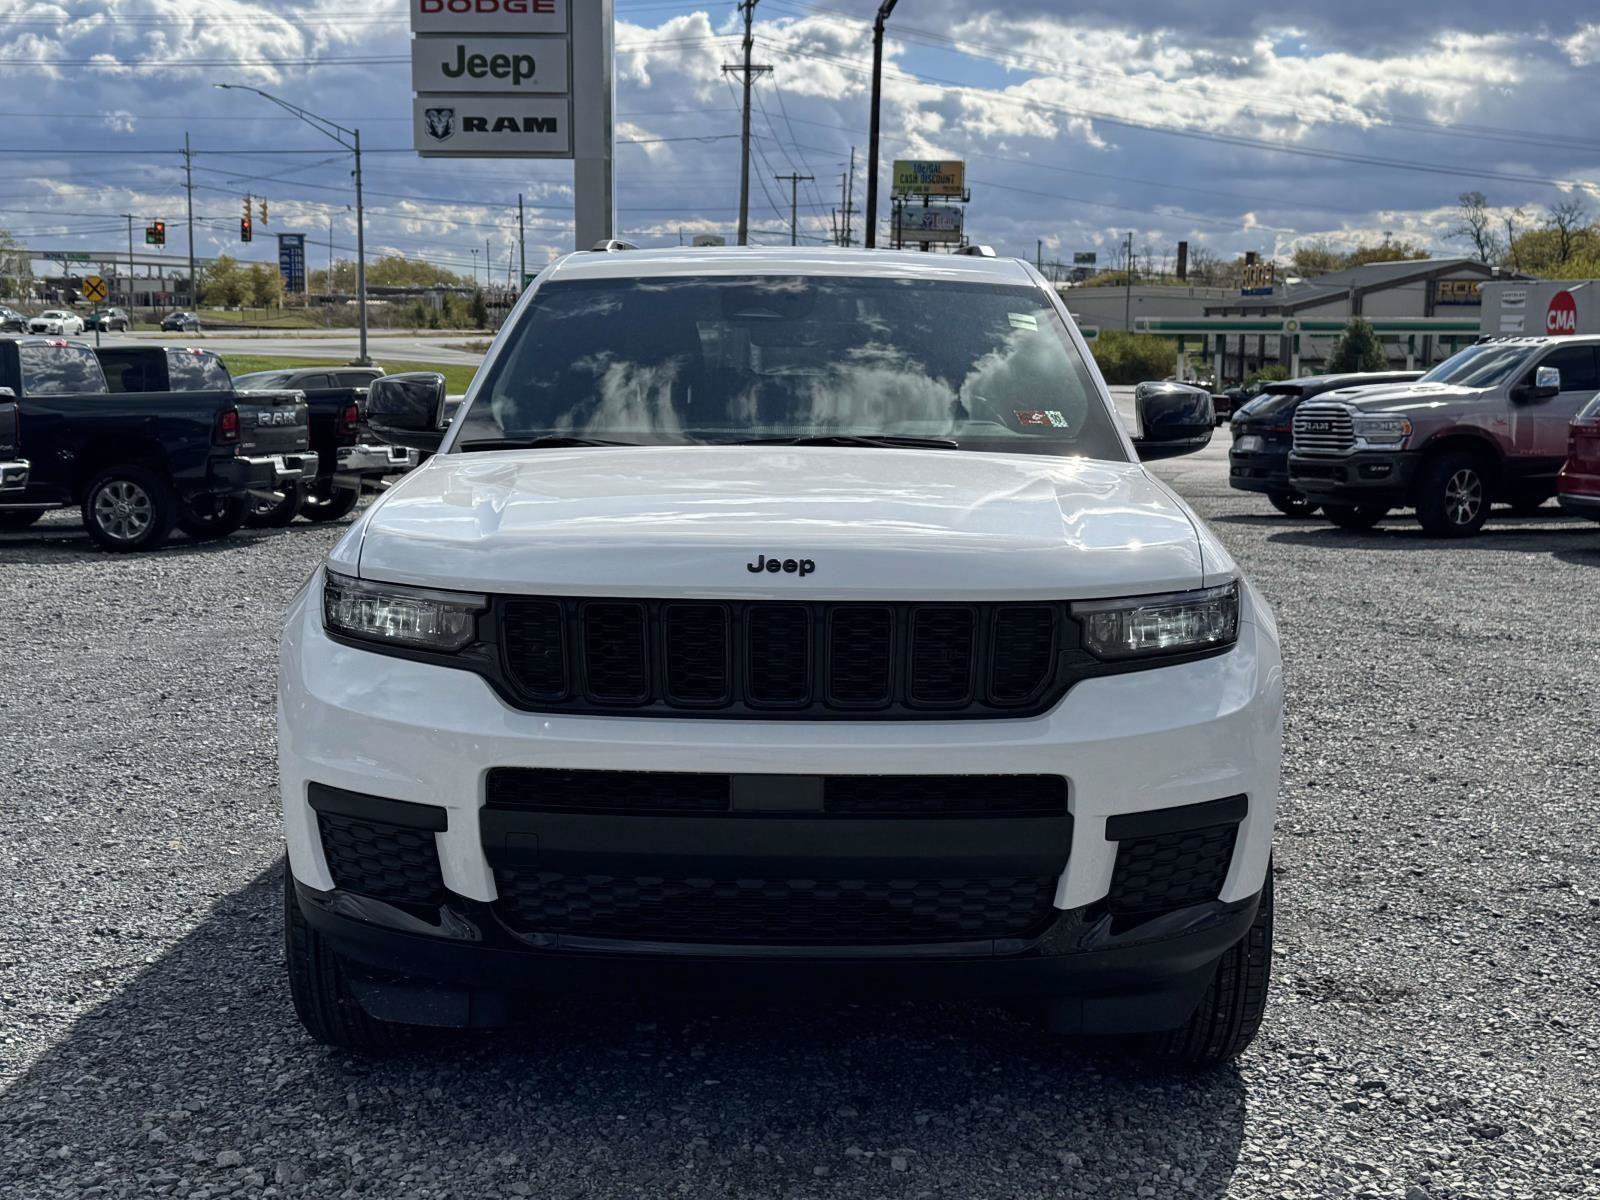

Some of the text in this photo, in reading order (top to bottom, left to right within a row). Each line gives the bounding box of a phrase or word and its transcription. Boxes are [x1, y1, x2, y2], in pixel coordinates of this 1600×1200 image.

[420, 0, 555, 13] DODGE
[442, 45, 536, 85] Jeep
[462, 117, 557, 133] RAM
[920, 174, 955, 184] DISCOUNT
[1547, 310, 1575, 330] CMA
[258, 412, 297, 425] RAM
[1304, 421, 1330, 430] RAM
[747, 554, 816, 577] Jeep
